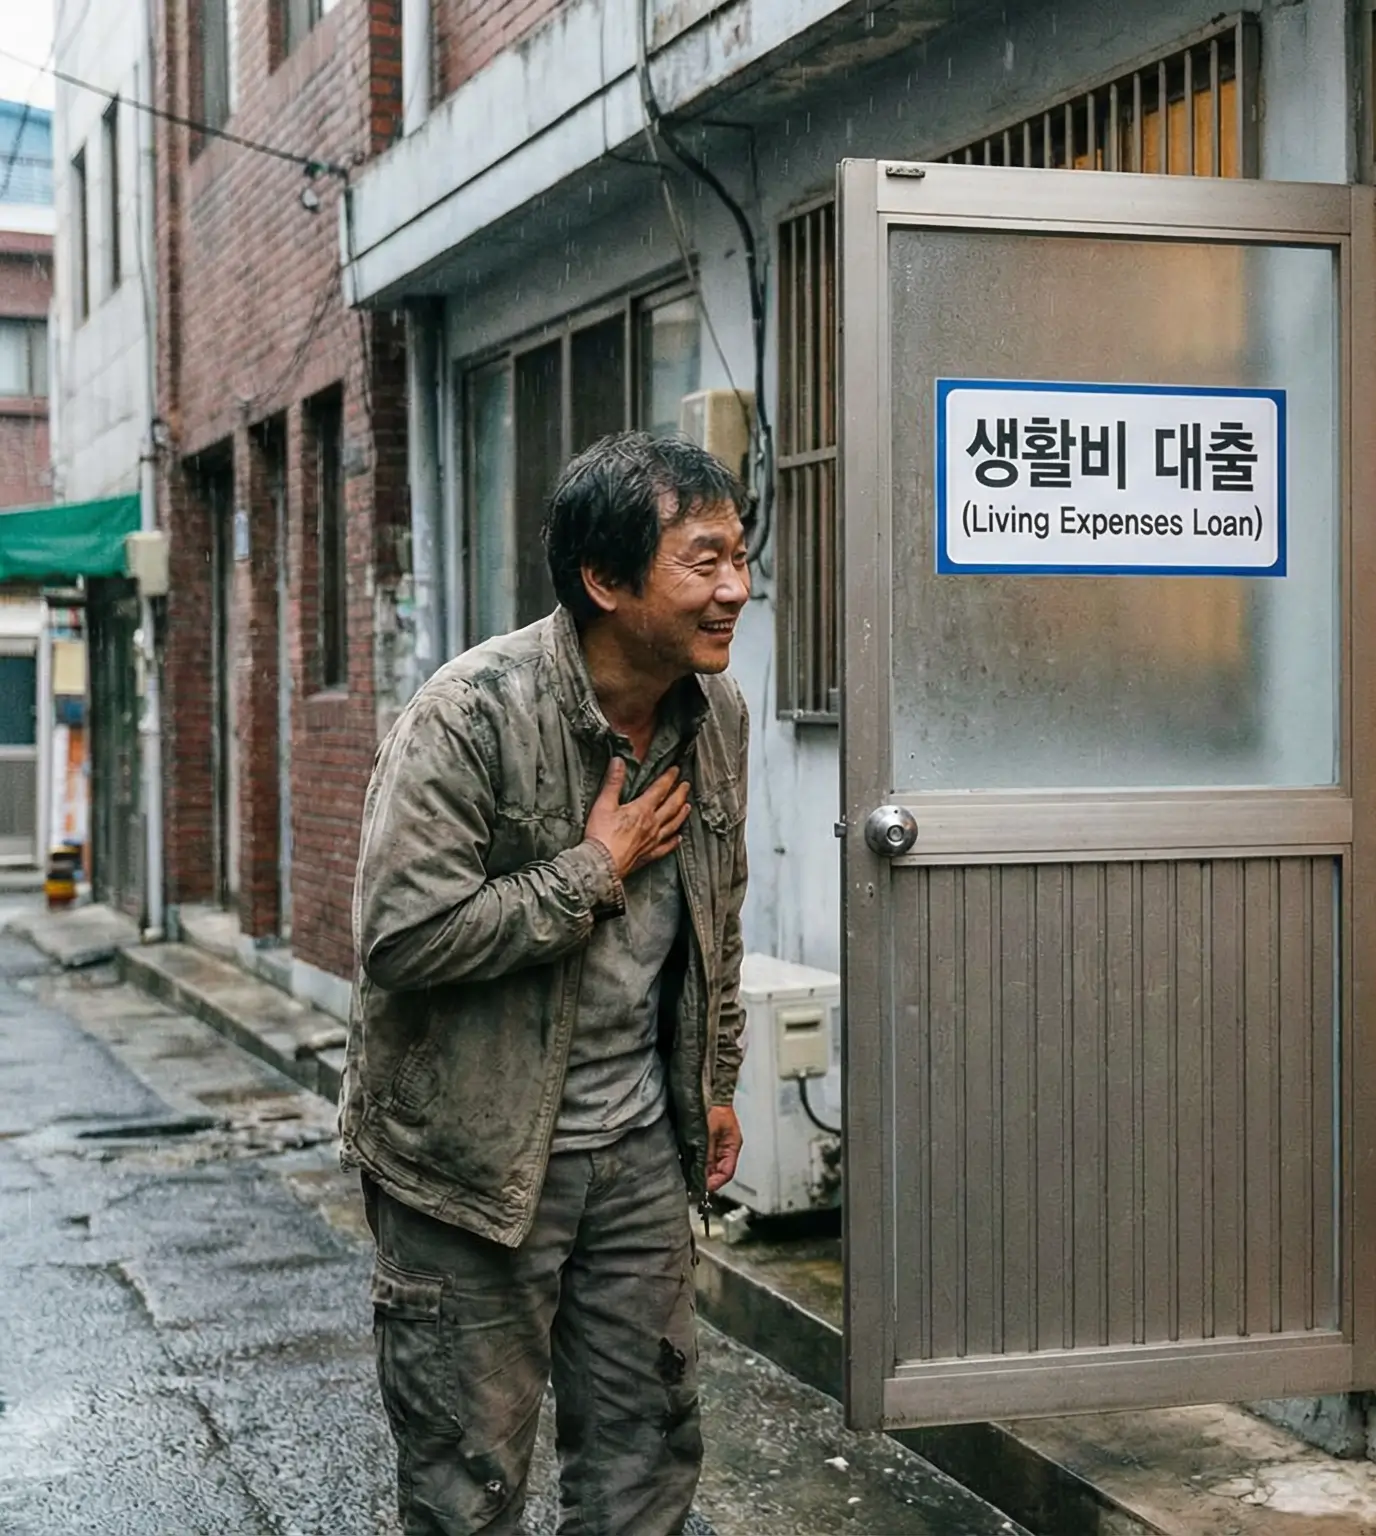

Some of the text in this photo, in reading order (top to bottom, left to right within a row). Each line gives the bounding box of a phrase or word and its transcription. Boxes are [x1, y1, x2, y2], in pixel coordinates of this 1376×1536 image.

[965, 417, 1258, 492] 생활비 대출
[962, 500, 1263, 542] (Living Expenses Loan)
